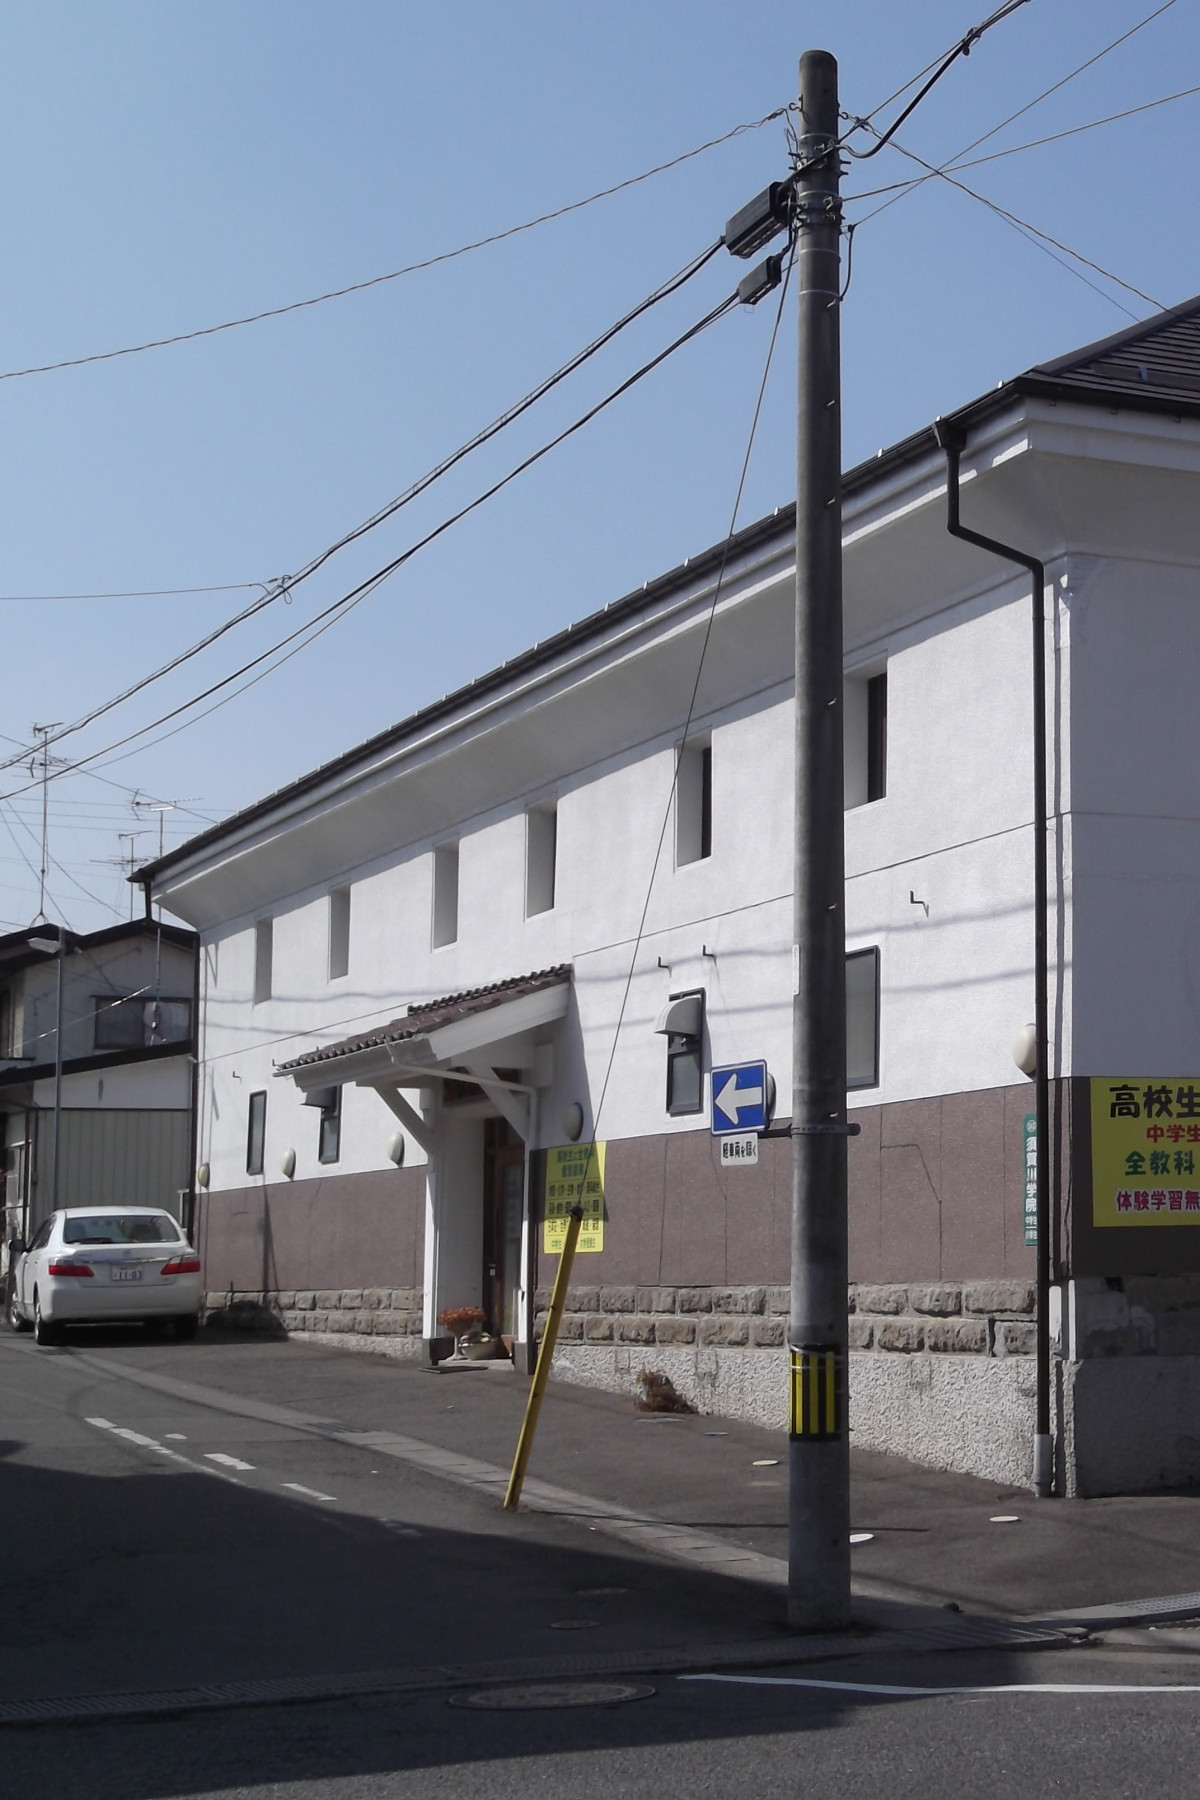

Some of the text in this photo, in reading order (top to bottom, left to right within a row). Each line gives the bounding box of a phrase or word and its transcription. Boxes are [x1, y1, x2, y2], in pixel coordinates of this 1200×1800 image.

[723, 1141, 756, 1158] 軽車両を除く
[1124, 1150, 1196, 1176] 全教科
